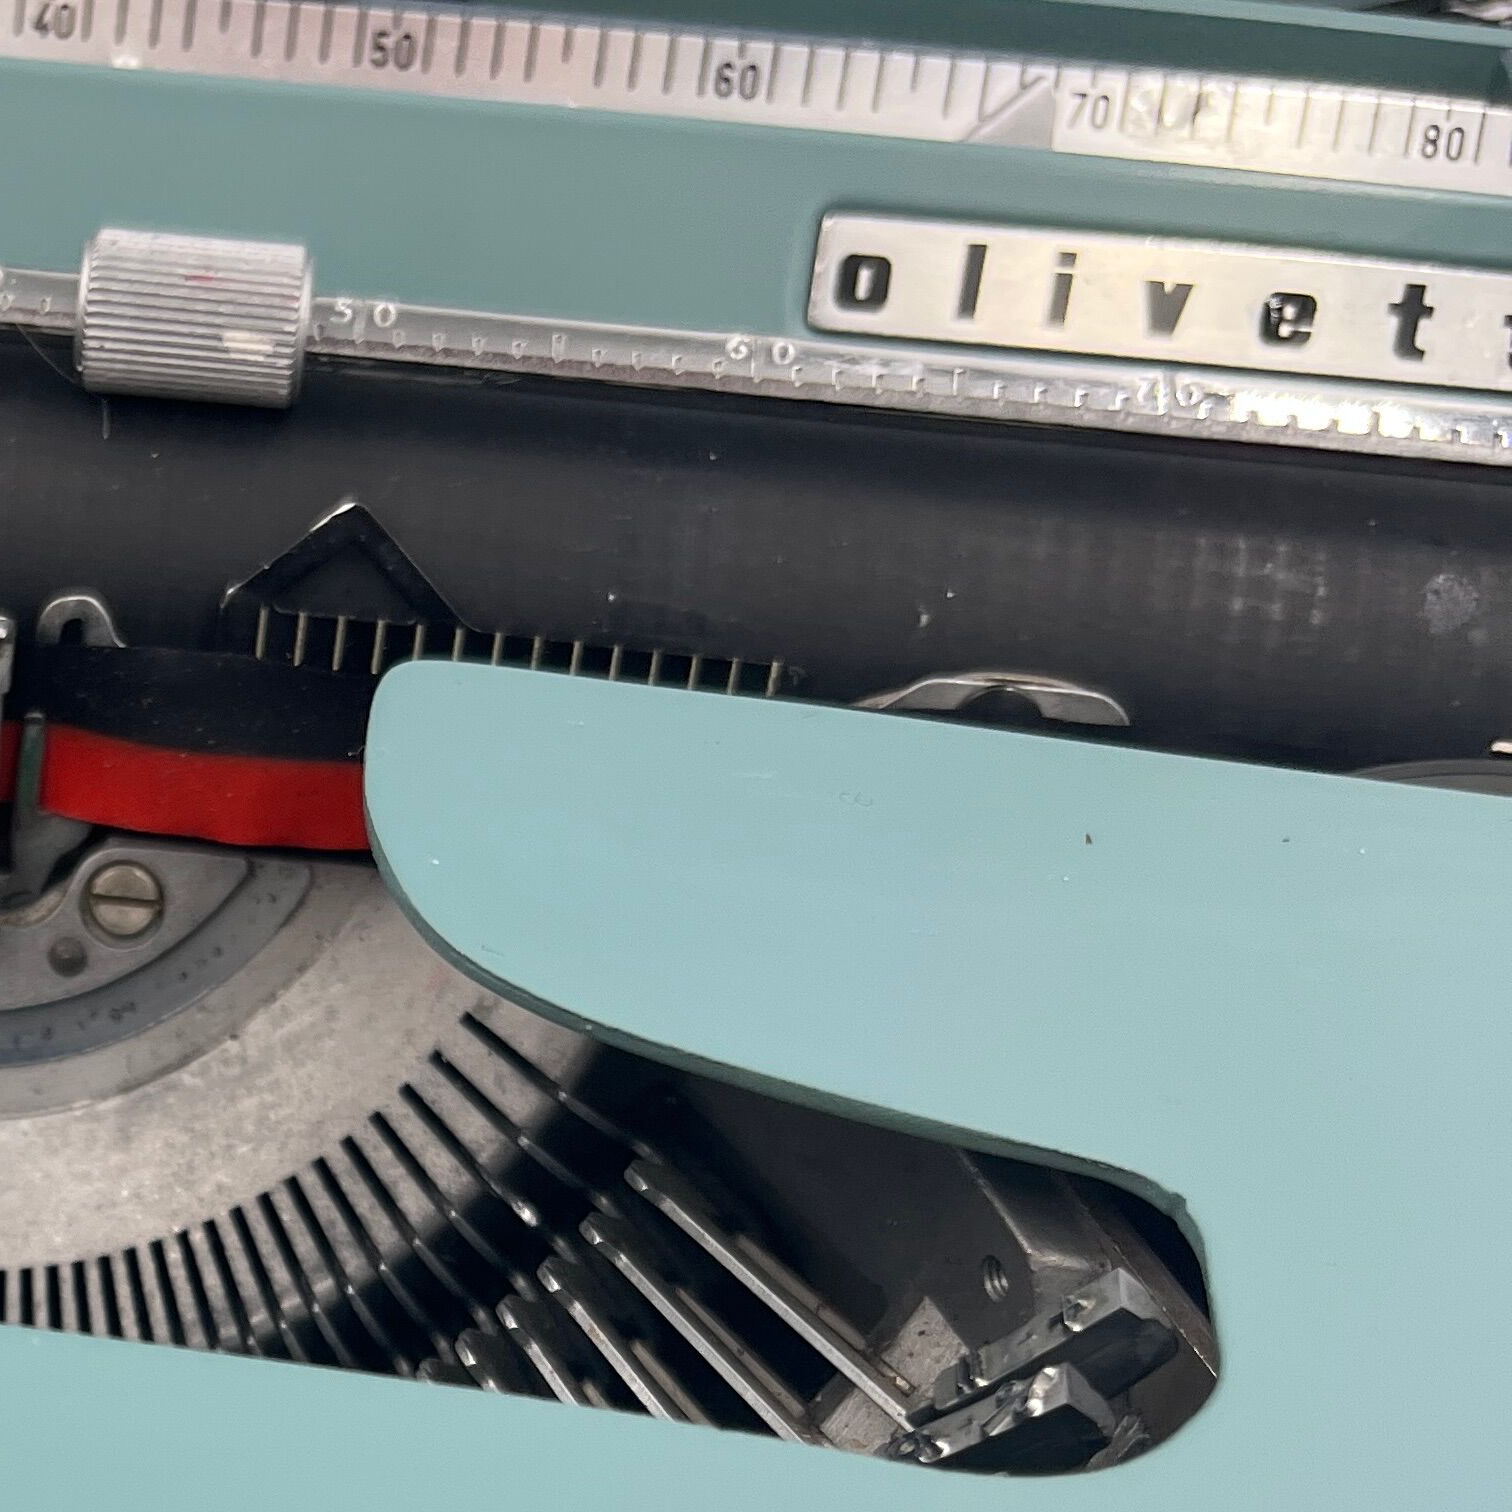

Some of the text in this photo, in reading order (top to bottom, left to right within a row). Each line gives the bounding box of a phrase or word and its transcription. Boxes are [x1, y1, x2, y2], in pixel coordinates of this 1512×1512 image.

[32, 2, 1467, 162] 40 50 60 70 80
[330, 297, 399, 327] 50
[724, 333, 797, 366] 60
[832, 243, 1512, 370] olivet
